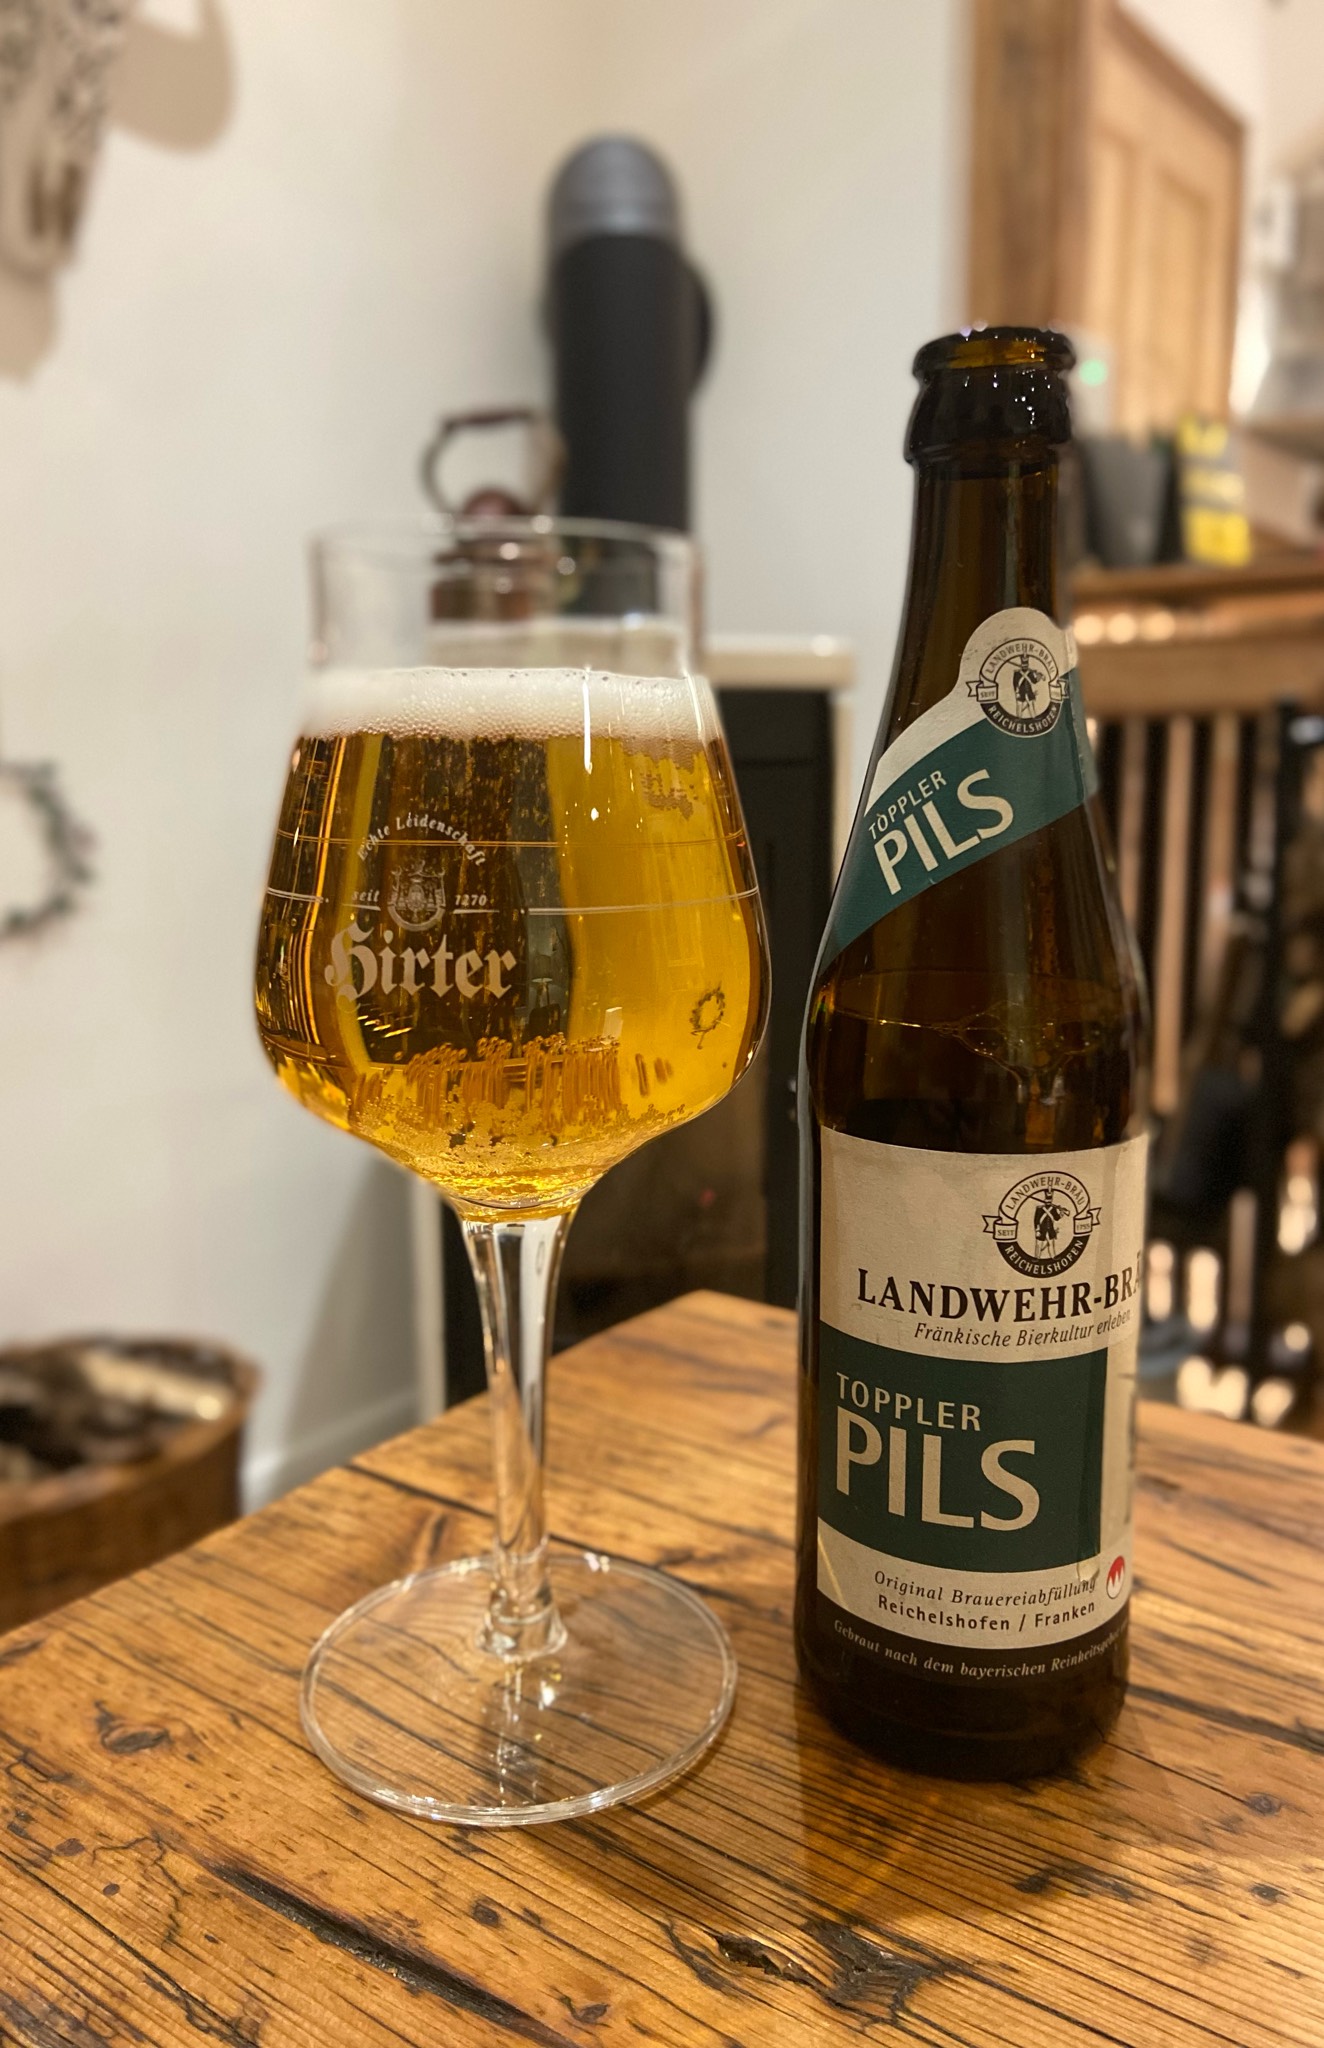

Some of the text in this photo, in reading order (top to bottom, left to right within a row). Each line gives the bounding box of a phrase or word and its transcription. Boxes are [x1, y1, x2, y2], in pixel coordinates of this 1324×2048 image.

[874, 768, 1014, 895] PILS
[454, 894, 488, 907] 1270
[324, 920, 517, 1012] Hirter
[1004, 1239, 1084, 1275] REICHELSHOFEN
[914, 1309, 1131, 1347] Fränkische Bierkultur erleben
[836, 1371, 981, 1431] TOPPLER
[836, 1405, 1041, 1531] PILS
[874, 1570, 1096, 1607] Original Brauereiabfüllung
[878, 1594, 1010, 1630] Reichelshofen
[1018, 1613, 1026, 1632] /
[1034, 1602, 1095, 1628] Franken
[834, 1619, 880, 1653] Gebraut
[885, 1647, 918, 1667] nach
[923, 1657, 954, 1674] dem
[960, 1661, 1046, 1680] bayerischen
